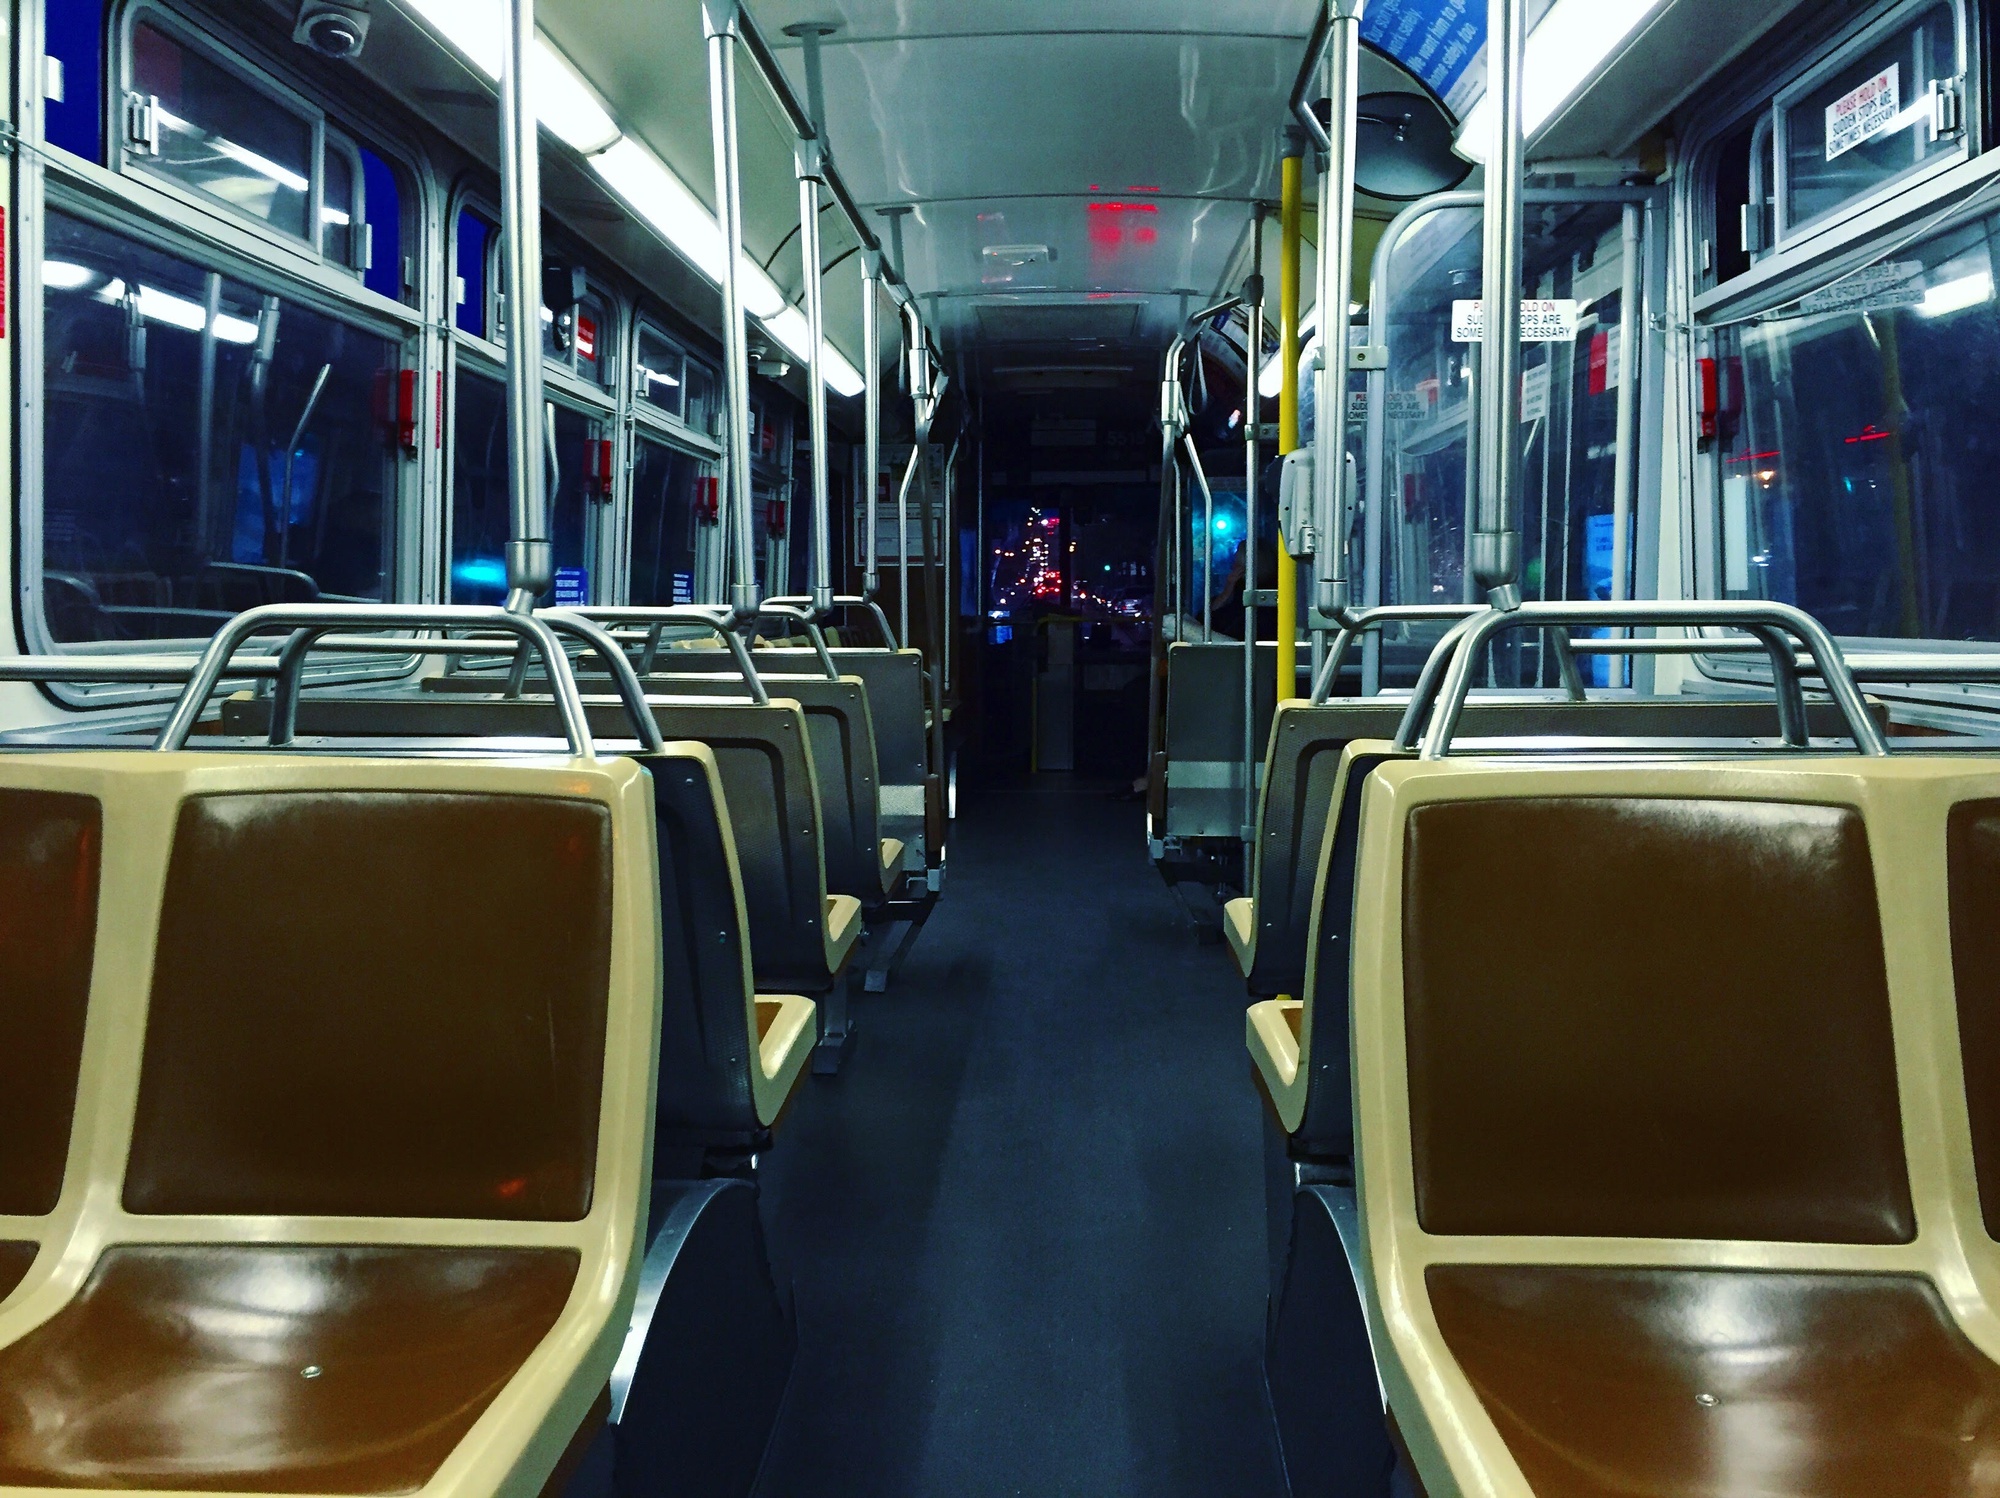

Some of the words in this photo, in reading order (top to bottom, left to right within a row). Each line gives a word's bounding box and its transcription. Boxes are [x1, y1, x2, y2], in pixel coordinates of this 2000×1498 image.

[1440, 7, 1457, 21] to
[1363, 25, 1384, 43] Our
[1375, 10, 1393, 29] son
[1427, 17, 1451, 39] him
[1387, 32, 1408, 56] work
[1417, 33, 1440, 59] want
[1406, 55, 1427, 74] We
[1424, 63, 1450, 91] home
[1836, 93, 1857, 116] PLEASE
[1858, 82, 1876, 102] HOLD
[1878, 75, 1888, 92] ON
[1833, 112, 1857, 137] SUDDEN
[1858, 98, 1878, 121] STOPS
[1880, 88, 1892, 106] ARE
[1829, 125, 1862, 156] SOMETIMES
[1863, 104, 1897, 134] NECESSARY
[1520, 302, 1539, 312] OLD
[1542, 302, 1556, 312] ON
[1467, 314, 1483, 325] SUD
[1520, 314, 1539, 325] OPS
[1542, 314, 1561, 325] ARE
[1520, 327, 1571, 337] ECESSARY
